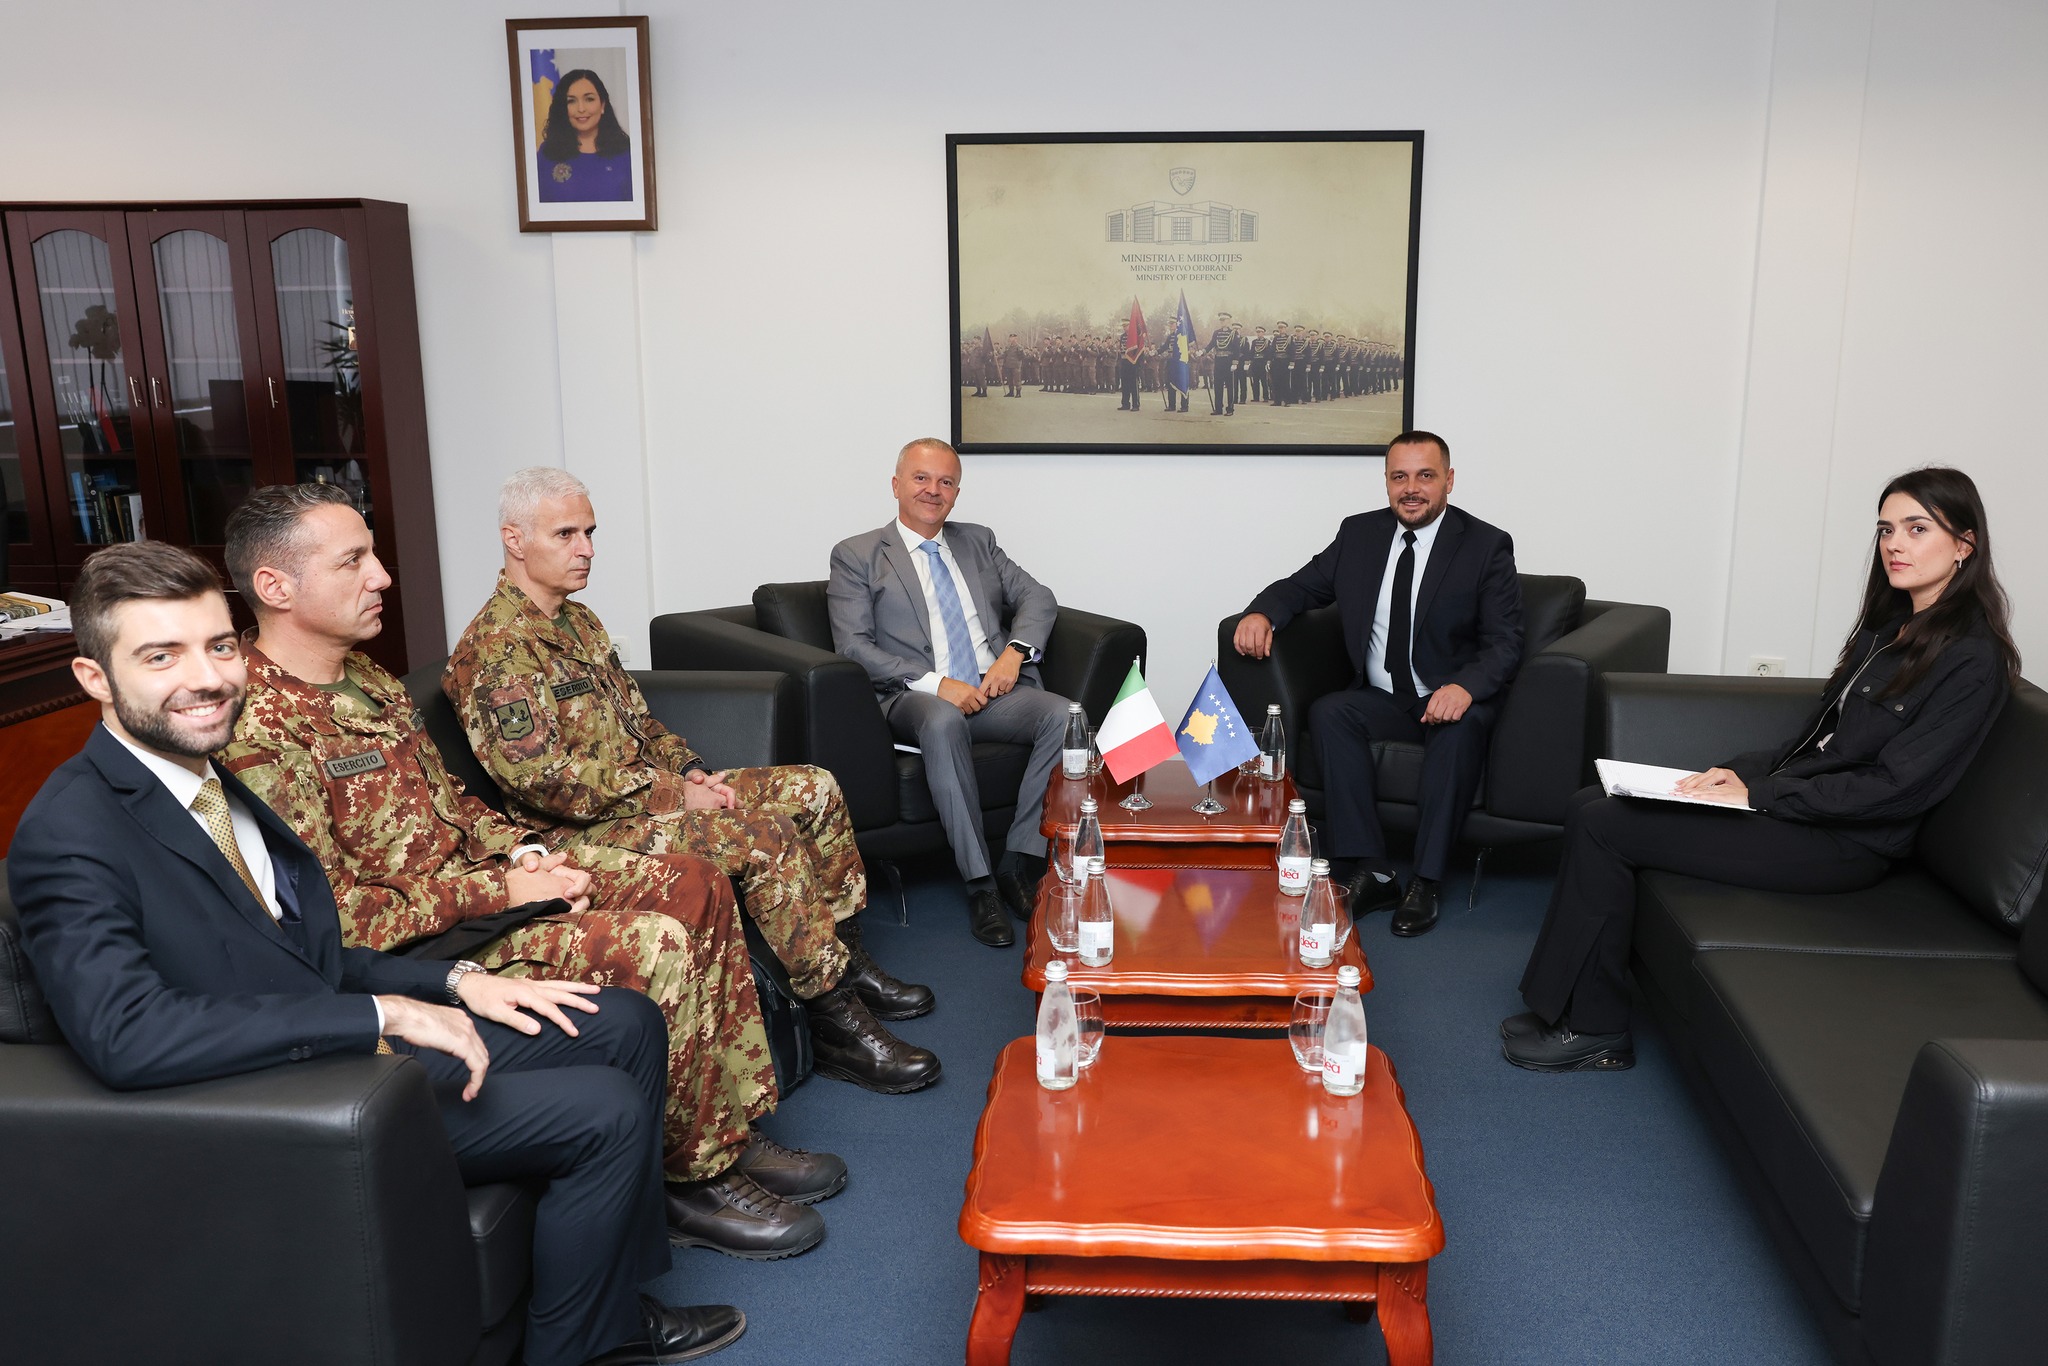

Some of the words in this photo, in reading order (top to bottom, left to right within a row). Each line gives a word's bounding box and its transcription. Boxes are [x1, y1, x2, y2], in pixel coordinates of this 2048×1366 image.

[1121, 253, 1175, 263] MINISTRIA
[1178, 253, 1185, 263] E
[1187, 253, 1243, 265] MBROJTJES
[1130, 264, 1191, 272] MINISTARSTVO
[1192, 264, 1233, 272] ODBRANE
[1136, 273, 1175, 281] MINISTRY
[1176, 273, 1188, 281] OF
[1189, 273, 1227, 281] DEFENCE
[331, 754, 379, 773] ESERCITO
[1280, 867, 1299, 880] dea
